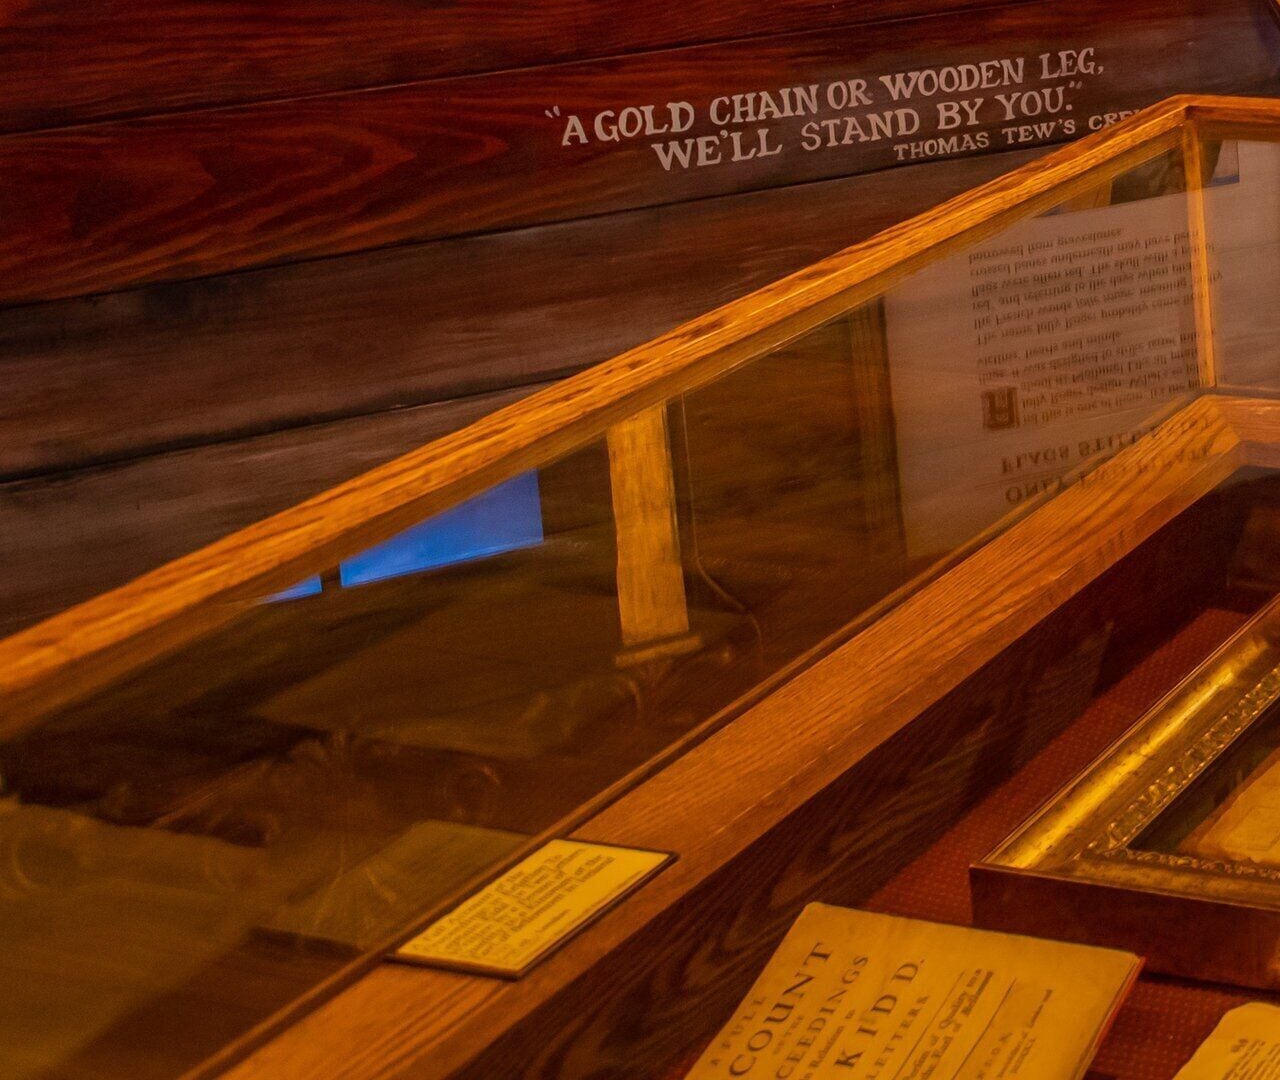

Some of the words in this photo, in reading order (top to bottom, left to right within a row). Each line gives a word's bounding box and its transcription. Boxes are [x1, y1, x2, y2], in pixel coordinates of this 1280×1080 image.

[594, 101, 694, 142] GOLD
[710, 84, 819, 126] CHAIN
[827, 79, 873, 110] OR
[879, 57, 1024, 100] WOODEN
[1039, 47, 1104, 80] LEG,
[651, 129, 783, 170] WE'LL
[801, 108, 920, 151] STAND
[936, 98, 984, 130] BY
[893, 132, 989, 160] THOMAS
[1002, 118, 1076, 145] TEW'S
